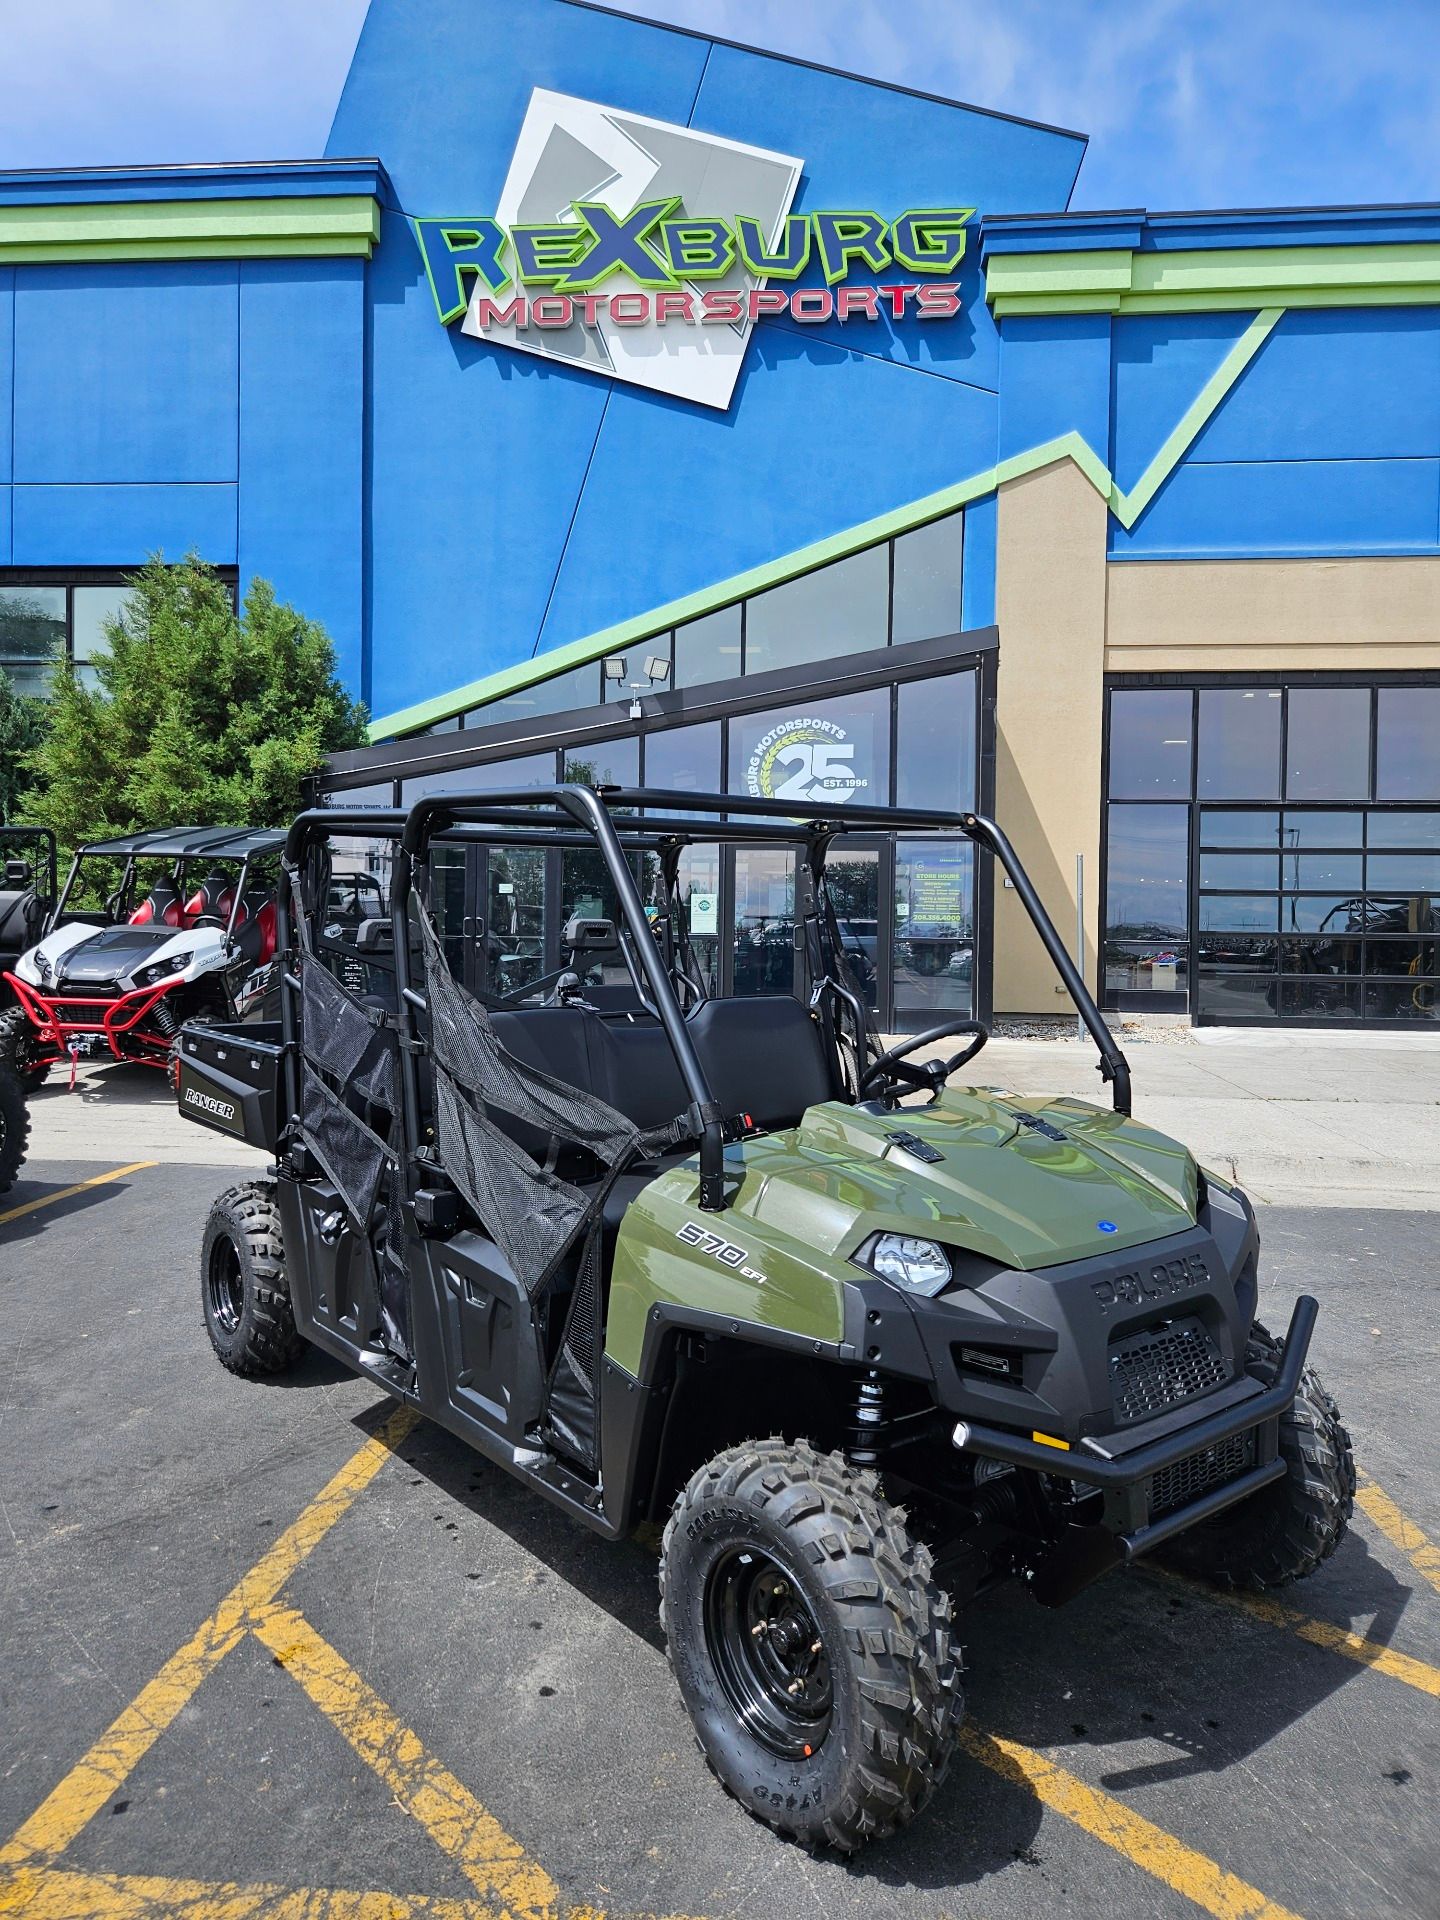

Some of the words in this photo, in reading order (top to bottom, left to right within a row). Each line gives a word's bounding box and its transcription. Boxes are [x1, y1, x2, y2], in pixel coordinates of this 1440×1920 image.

[414, 196, 977, 326] REXBURG
[479, 283, 962, 331] MOTORSPORTS
[754, 718, 847, 756] MOTORSPORTS
[775, 744, 855, 803] 25
[823, 779, 844, 788] EST.
[845, 779, 868, 788] 1996
[185, 1087, 235, 1120] RANGER
[675, 1221, 749, 1268] 570
[739, 1266, 768, 1284] EFI
[1089, 1253, 1211, 1316] POLARIS
[686, 1506, 761, 1541] CARLISLE
